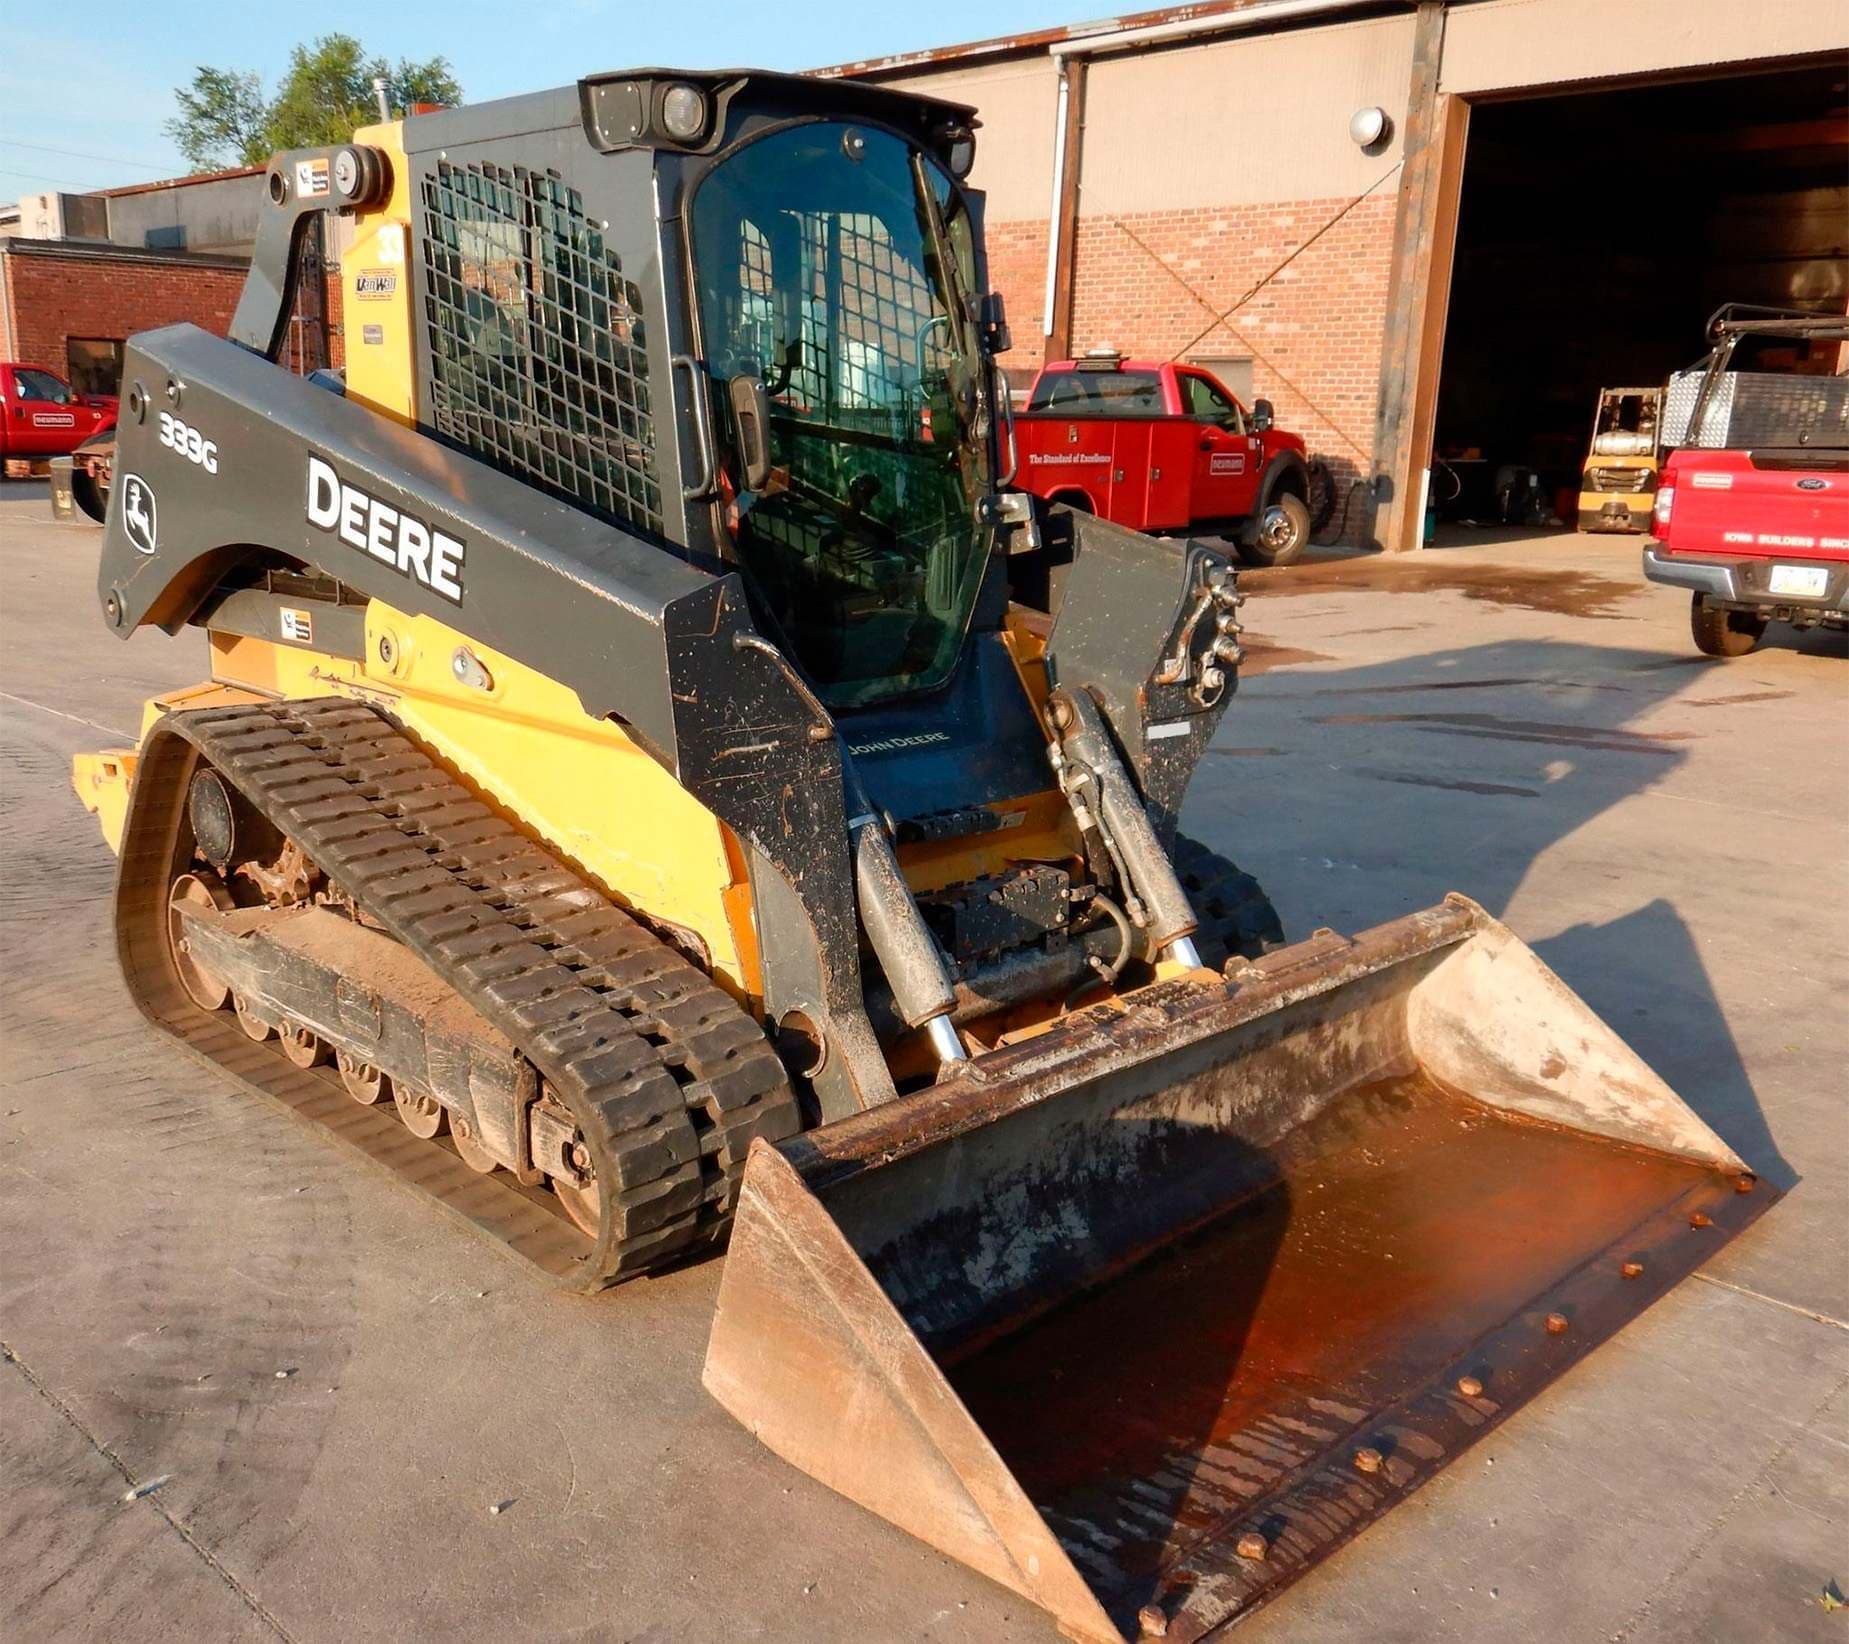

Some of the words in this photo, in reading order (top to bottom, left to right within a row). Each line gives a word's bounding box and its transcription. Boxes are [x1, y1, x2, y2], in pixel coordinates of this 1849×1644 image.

[158, 411, 218, 475] 333G
[1029, 454, 1042, 464] The
[1043, 453, 1072, 464] Standard
[1080, 453, 1111, 463] Excellence
[307, 456, 465, 601] DEERE
[1724, 532, 1753, 543] IOWA
[1758, 534, 1815, 548] BUILDERS
[847, 741, 895, 756] JOHN
[889, 732, 951, 748] DEERE
